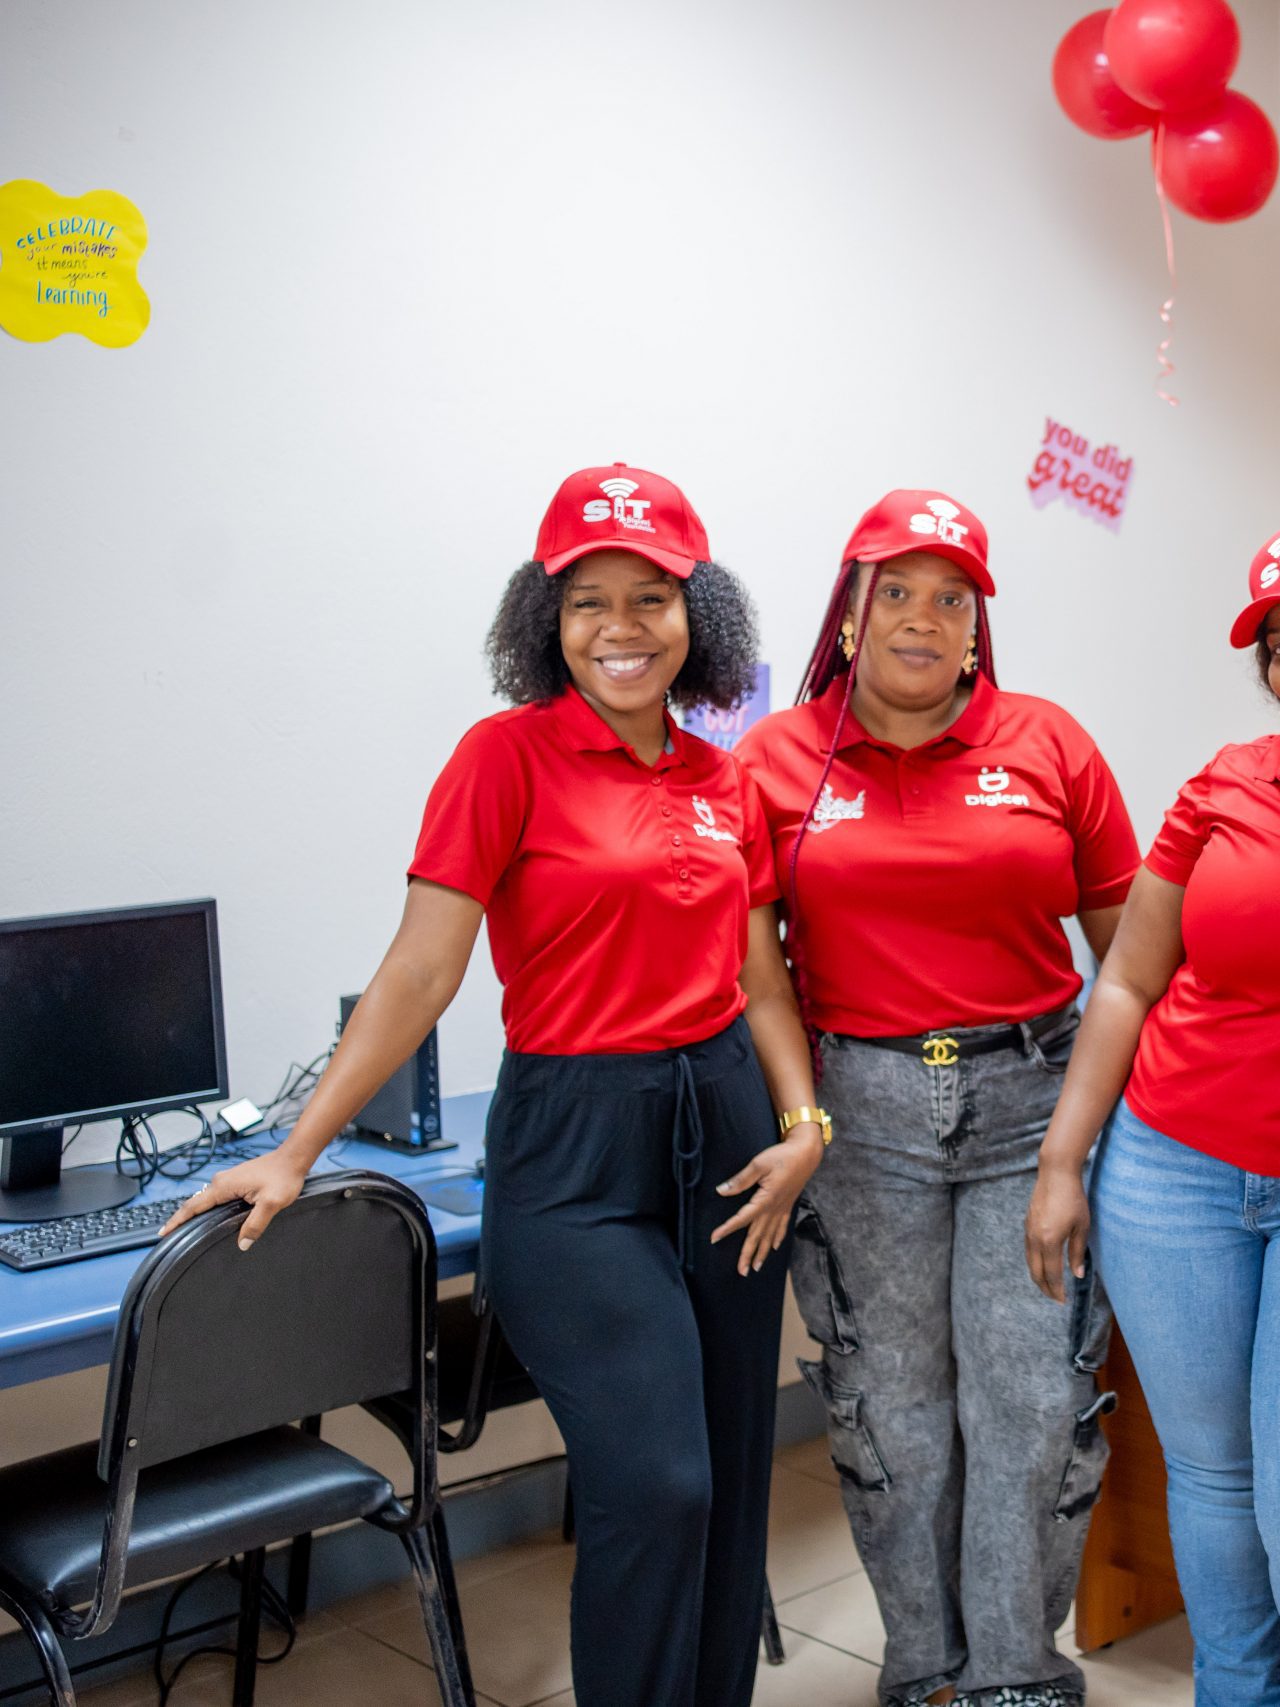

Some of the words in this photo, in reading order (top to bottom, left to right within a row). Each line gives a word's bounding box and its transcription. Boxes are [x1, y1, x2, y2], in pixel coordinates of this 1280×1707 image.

[1041, 415, 1089, 457] you
[1092, 443, 1133, 482] did
[1027, 450, 1123, 518] great
